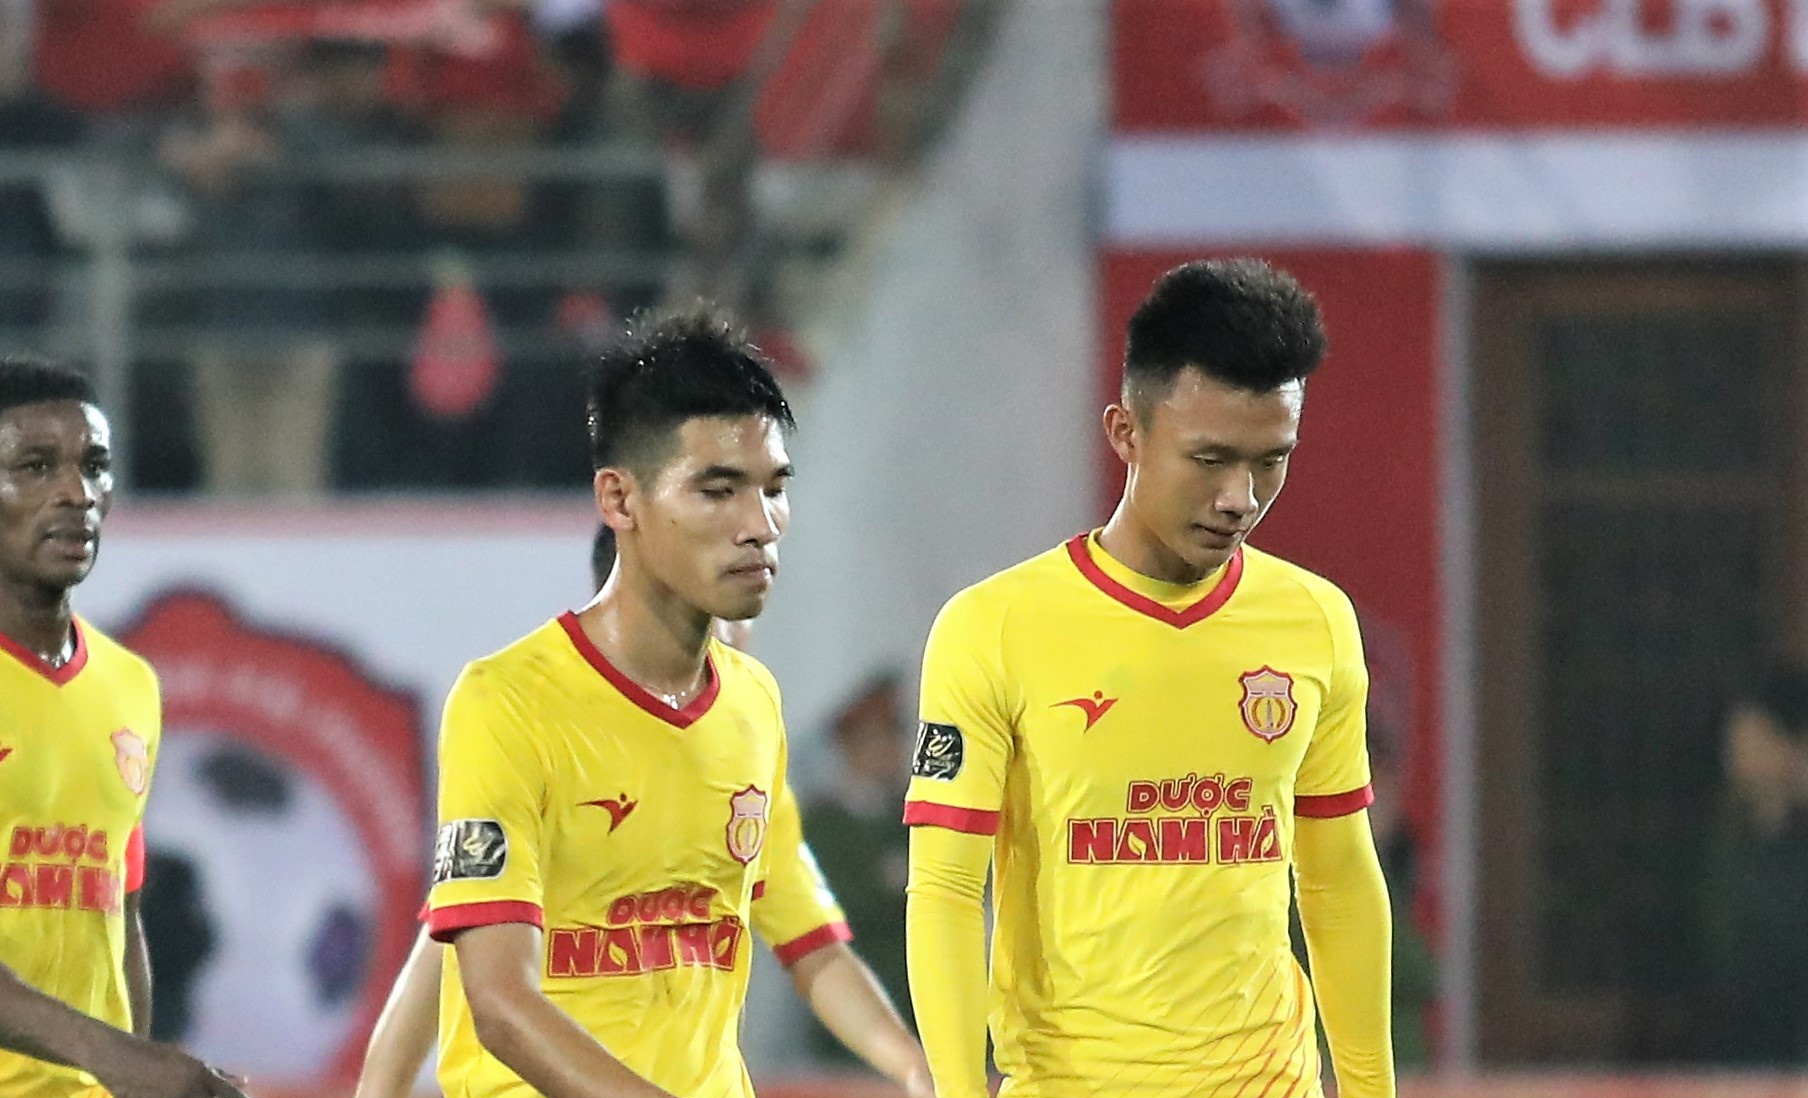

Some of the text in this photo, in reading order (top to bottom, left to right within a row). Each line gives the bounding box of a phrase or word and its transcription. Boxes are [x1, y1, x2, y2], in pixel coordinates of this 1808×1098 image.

[1126, 773, 1253, 817] DƯỢC
[8, 823, 108, 864] DƯỢC
[1066, 805, 1283, 864] NAM HÀ
